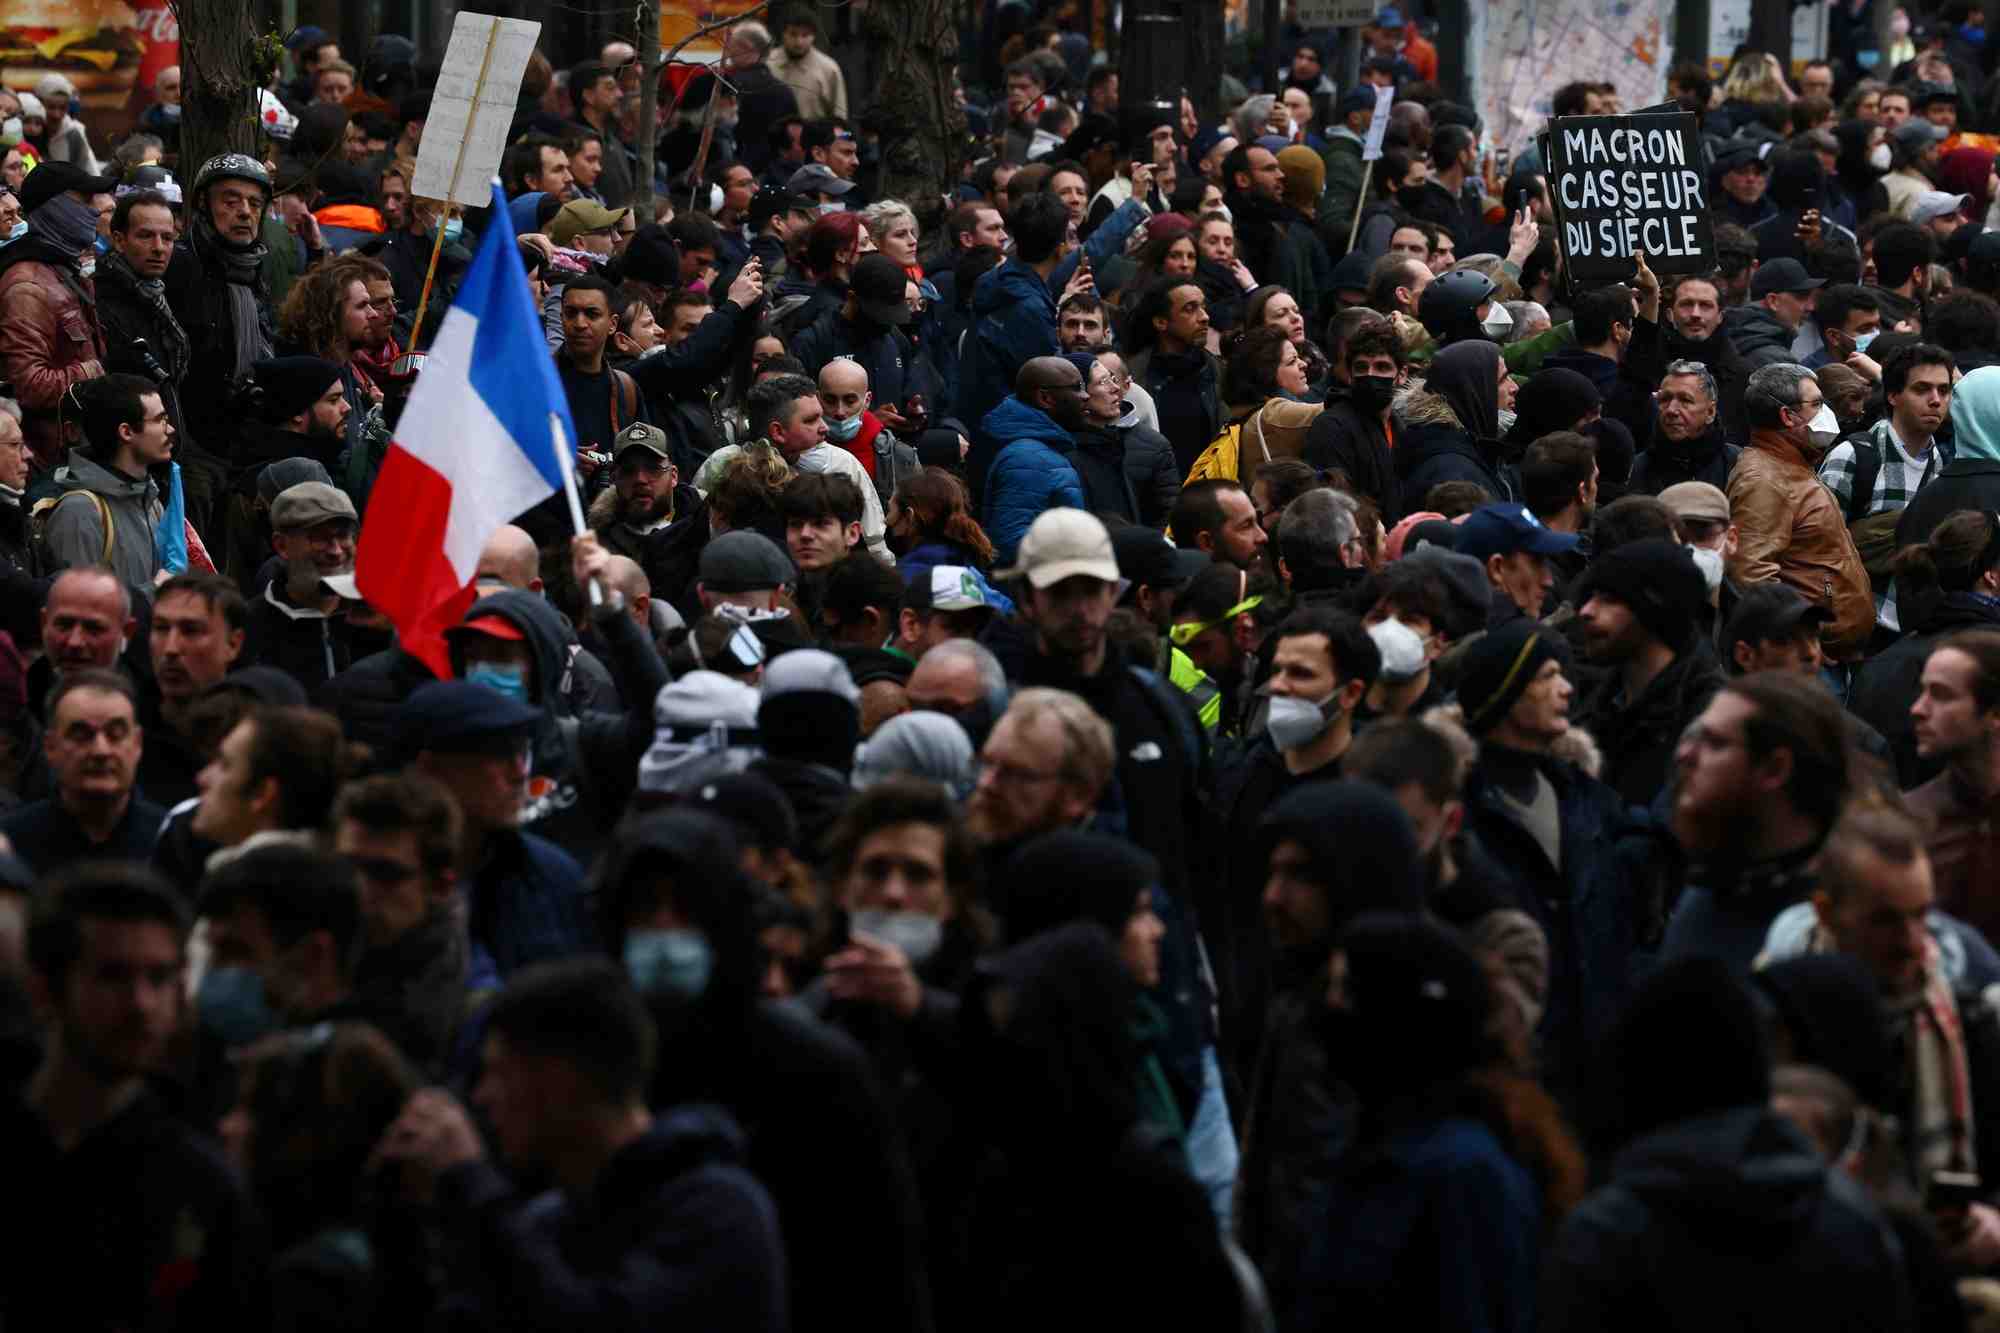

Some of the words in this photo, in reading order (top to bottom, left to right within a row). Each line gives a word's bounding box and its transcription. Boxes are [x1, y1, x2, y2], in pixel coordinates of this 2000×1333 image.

[1563, 128, 1686, 166] MACRON
[1560, 169, 1705, 210] CASSEUR
[1566, 220, 1593, 257] DU
